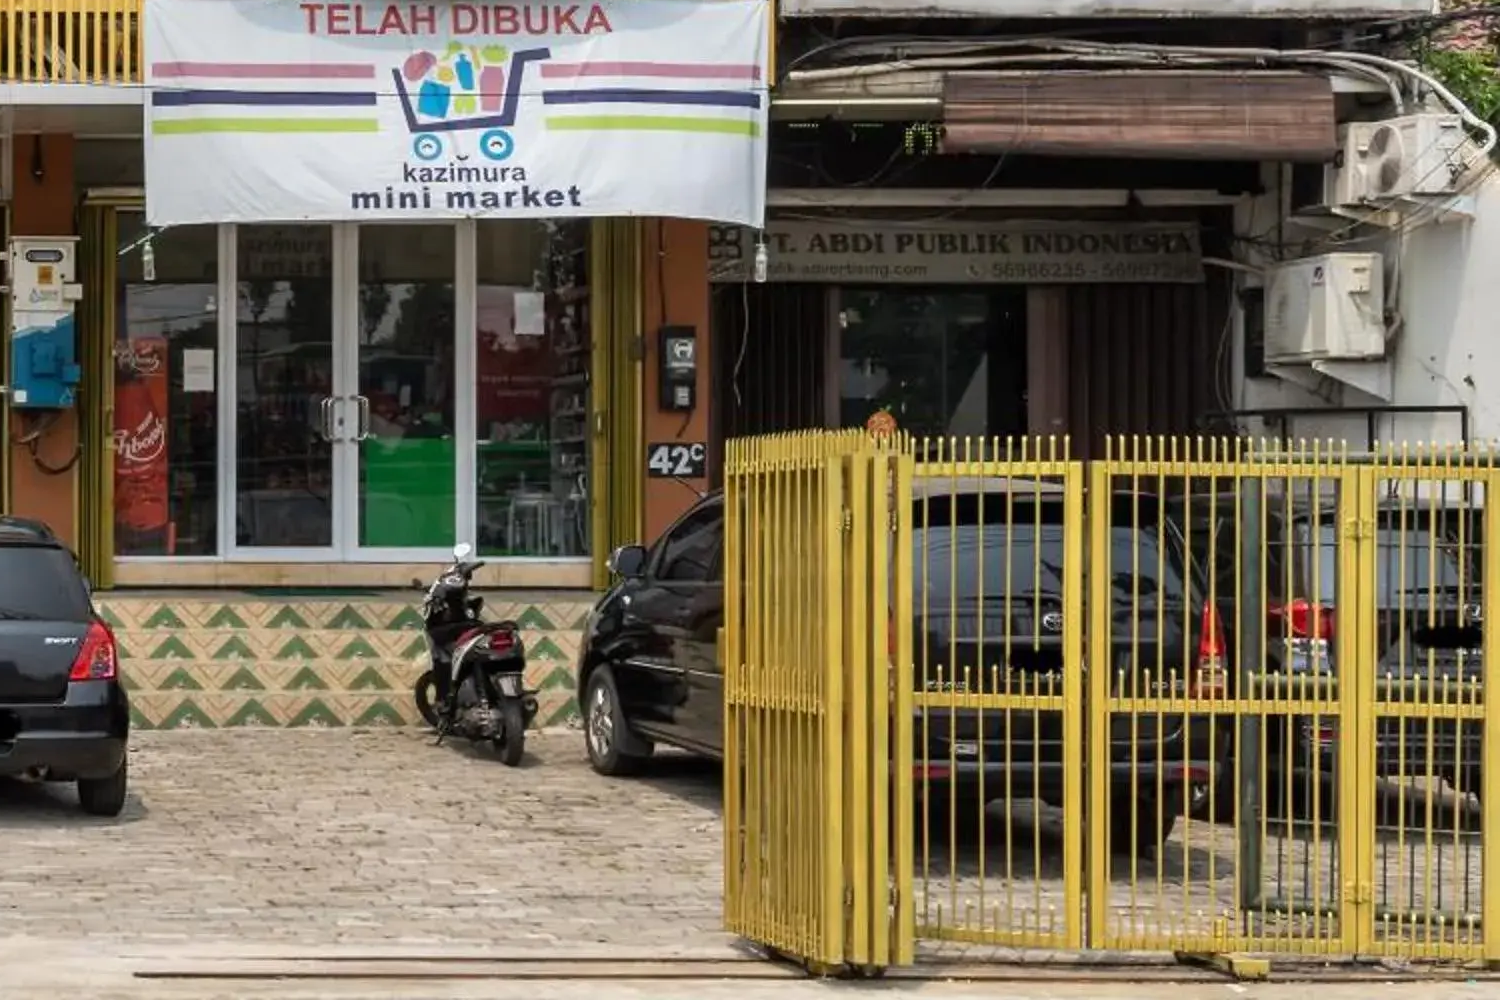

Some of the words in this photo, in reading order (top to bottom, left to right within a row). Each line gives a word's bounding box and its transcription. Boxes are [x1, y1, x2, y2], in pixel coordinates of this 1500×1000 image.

[300, 3, 436, 36] TELAH
[452, 3, 613, 36] DIBUKA
[402, 159, 527, 184] kazimura
[351, 185, 432, 210] mini
[446, 184, 582, 211] market
[808, 233, 884, 254] ABDI
[895, 233, 1010, 254] PUBLIK
